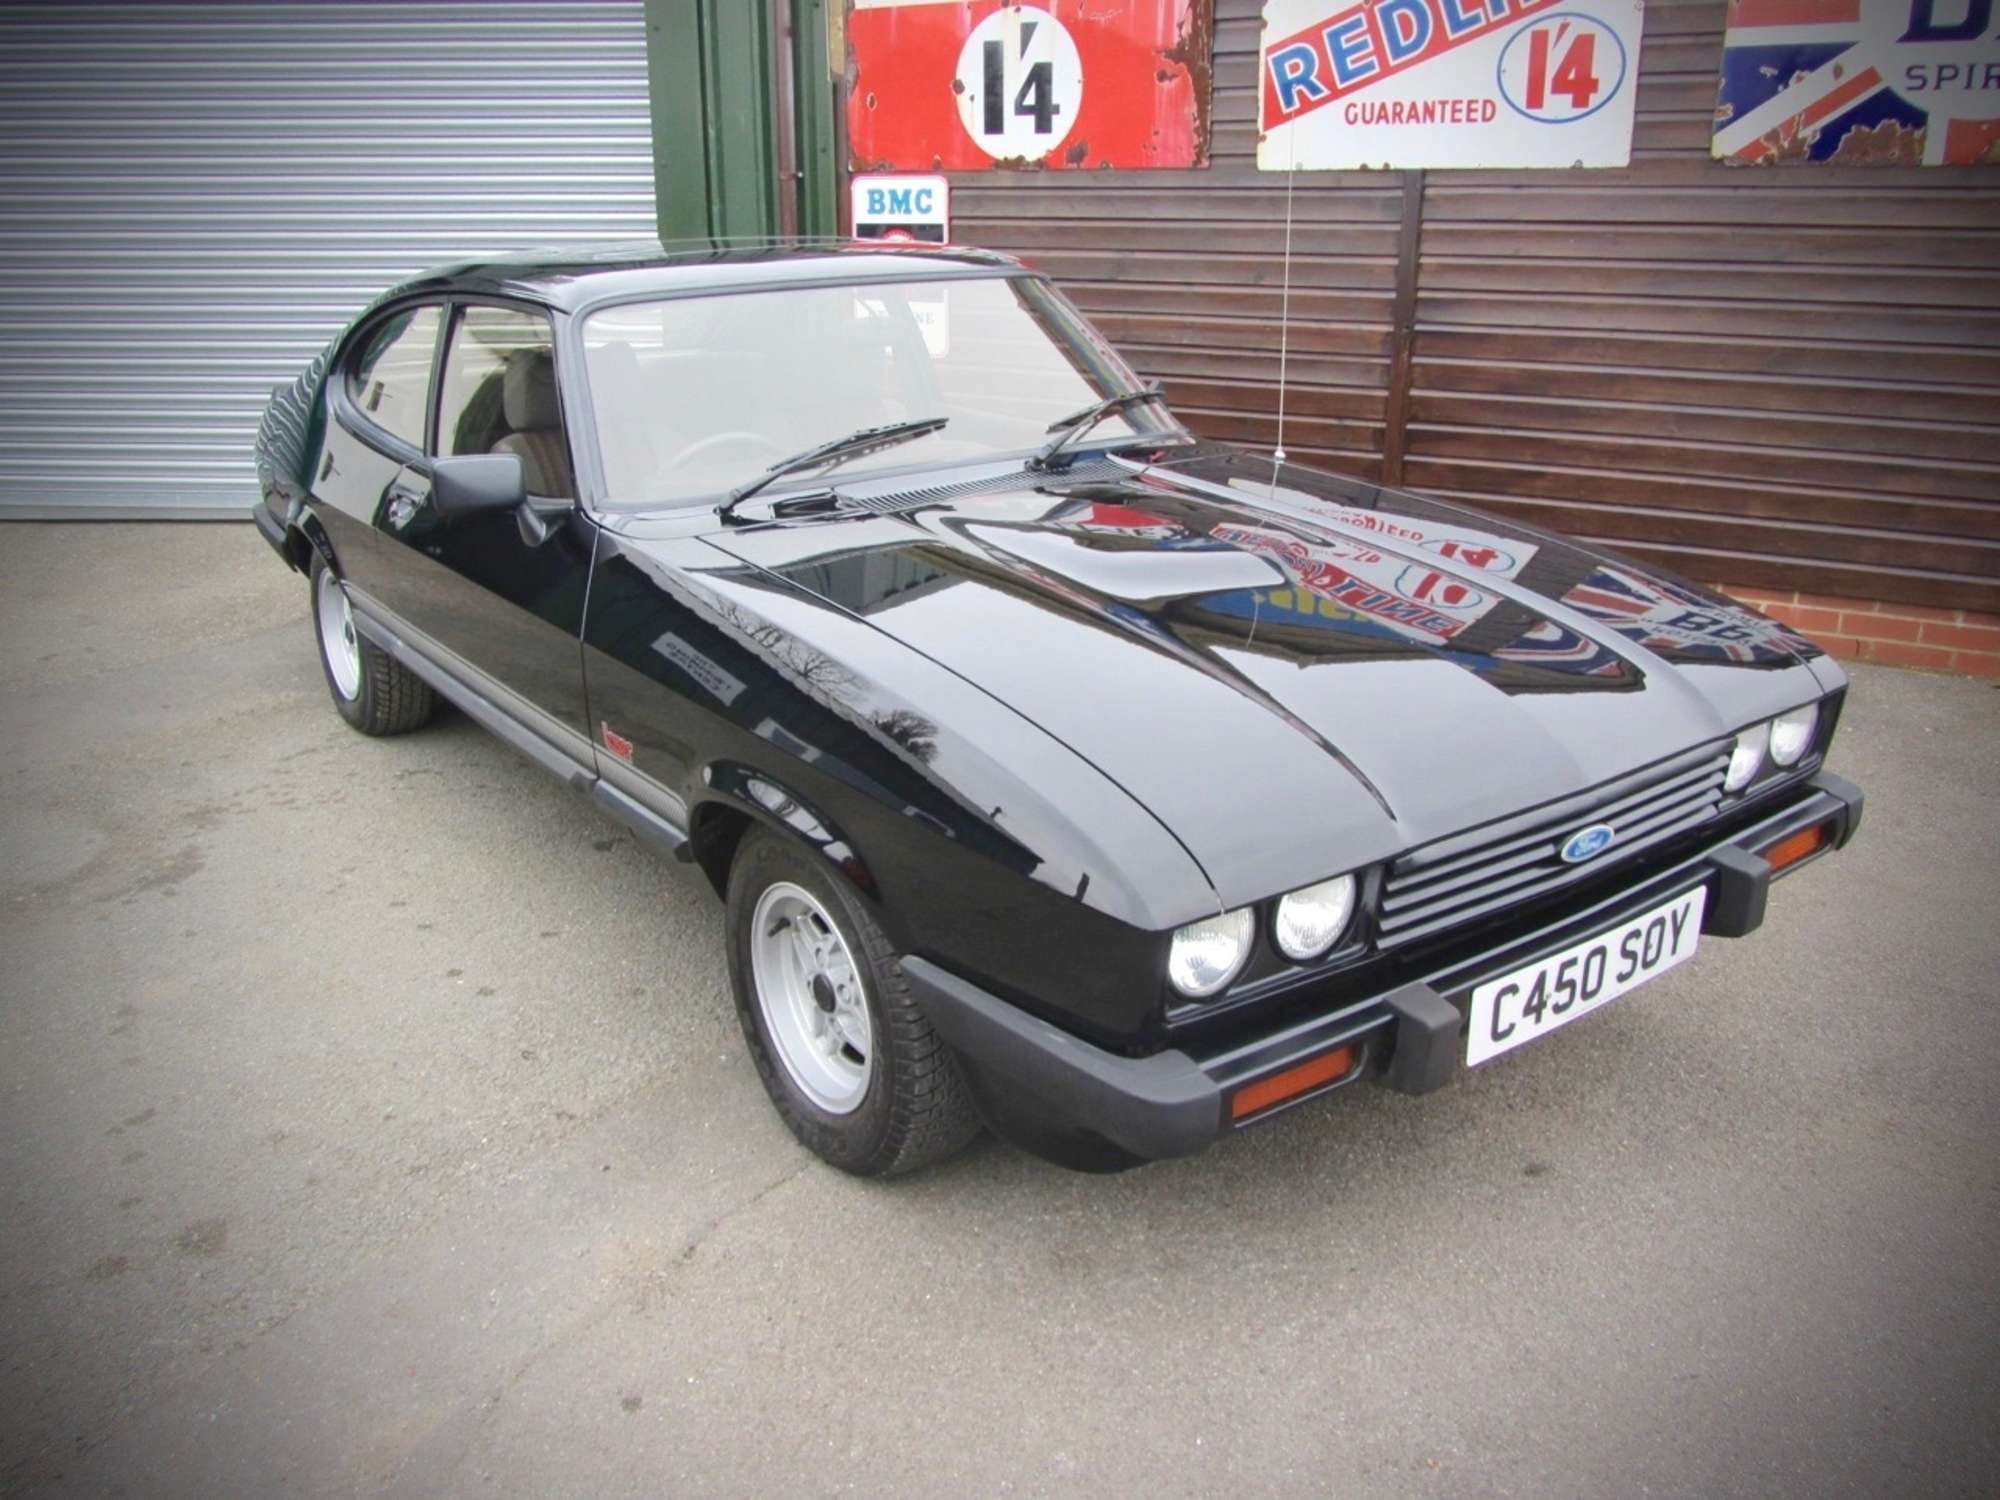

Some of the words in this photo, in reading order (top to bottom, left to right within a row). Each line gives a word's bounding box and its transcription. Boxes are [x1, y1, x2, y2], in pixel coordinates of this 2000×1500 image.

[1268, 0, 1540, 114] REDL
[1344, 99, 1497, 126] GUARANTEED
[867, 188, 932, 214] BMC
[1491, 945, 1607, 1042] C450
[1616, 902, 1691, 983] SOY
